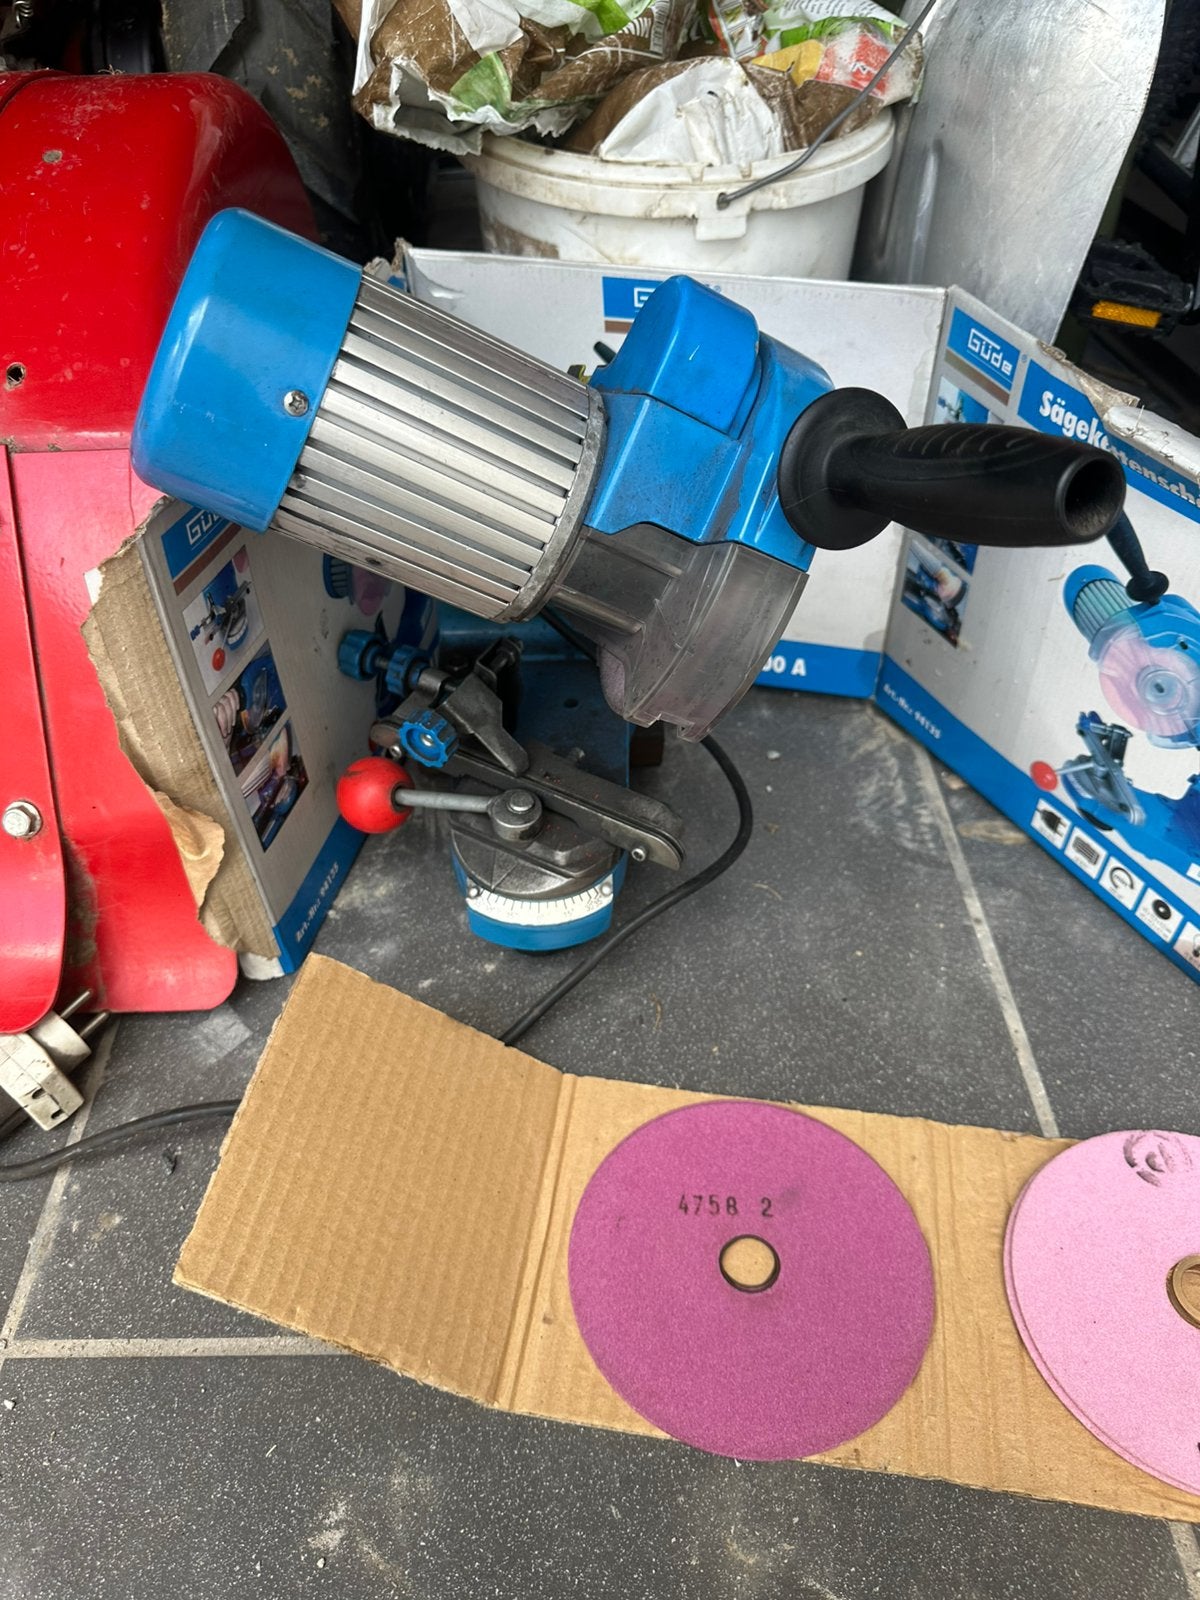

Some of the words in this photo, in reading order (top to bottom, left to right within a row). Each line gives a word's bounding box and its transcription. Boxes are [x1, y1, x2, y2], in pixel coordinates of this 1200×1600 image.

[967, 328, 1013, 376] Güde
[791, 657, 807, 676] A
[761, 1196, 774, 1218] 2
